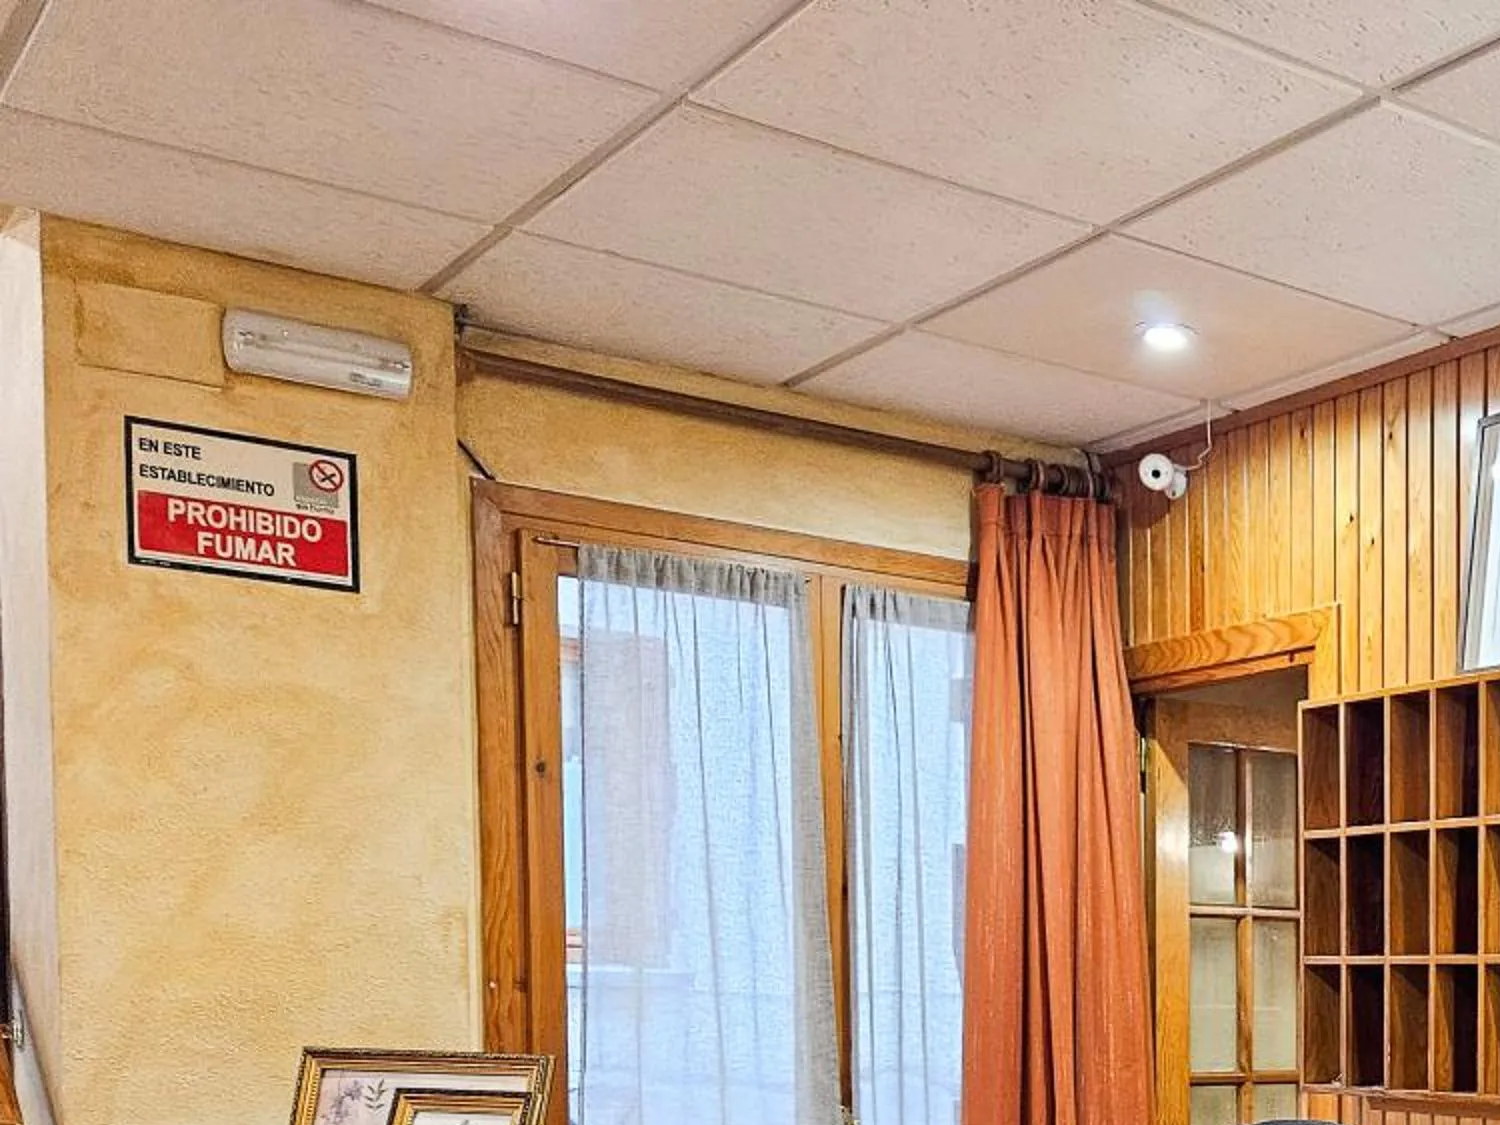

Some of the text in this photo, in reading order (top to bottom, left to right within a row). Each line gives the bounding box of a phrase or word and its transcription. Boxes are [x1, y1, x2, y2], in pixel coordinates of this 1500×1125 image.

[139, 437, 202, 460] EN ESTE
[139, 463, 275, 497] ESTABLECIMIENTO
[167, 498, 323, 543] PROHIBIDO
[197, 531, 296, 567] FUMAR
